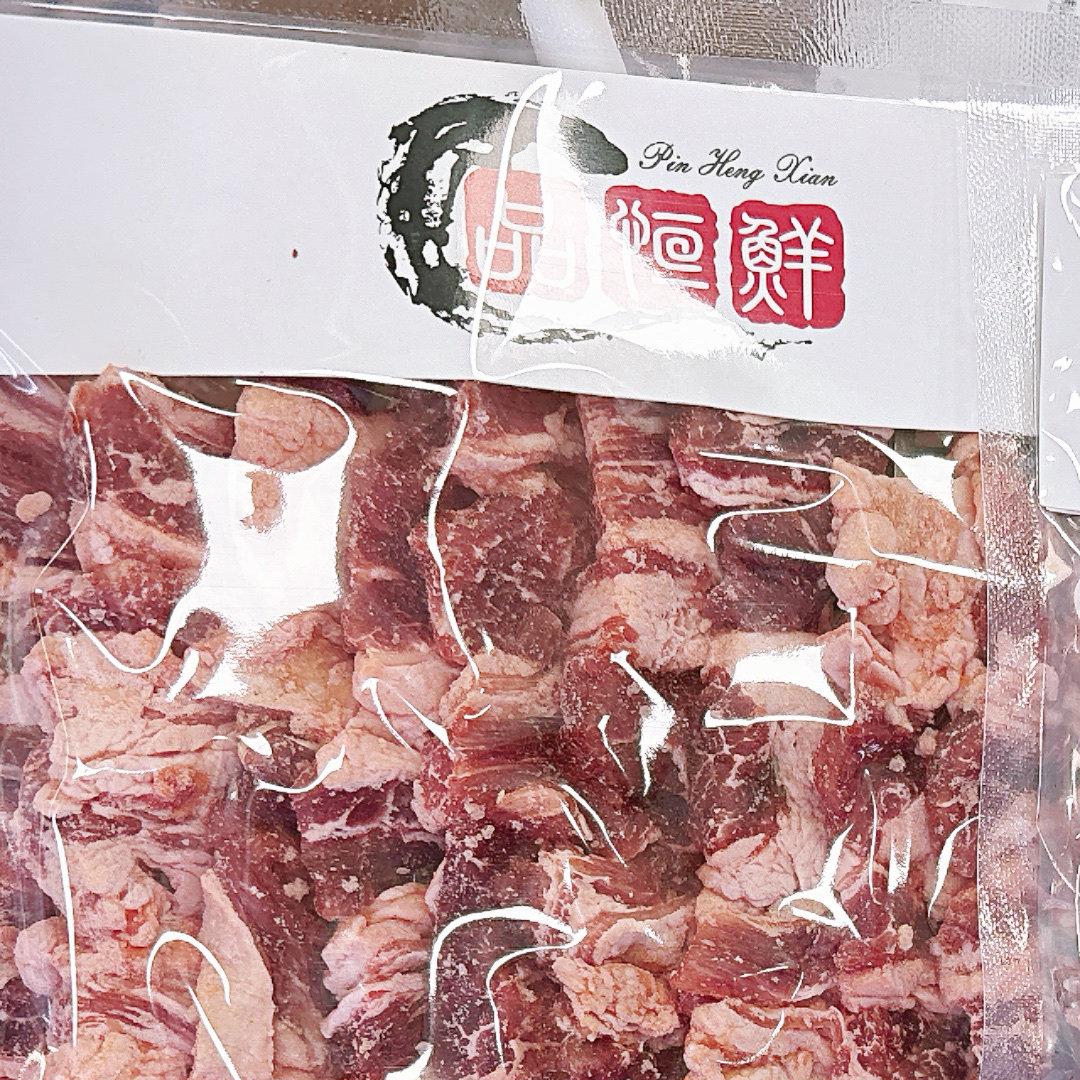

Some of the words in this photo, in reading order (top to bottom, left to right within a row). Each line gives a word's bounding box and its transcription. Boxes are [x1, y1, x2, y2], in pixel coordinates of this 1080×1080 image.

[639, 141, 692, 174] Pin
[698, 147, 766, 190] Heng
[773, 152, 839, 187] Xian
